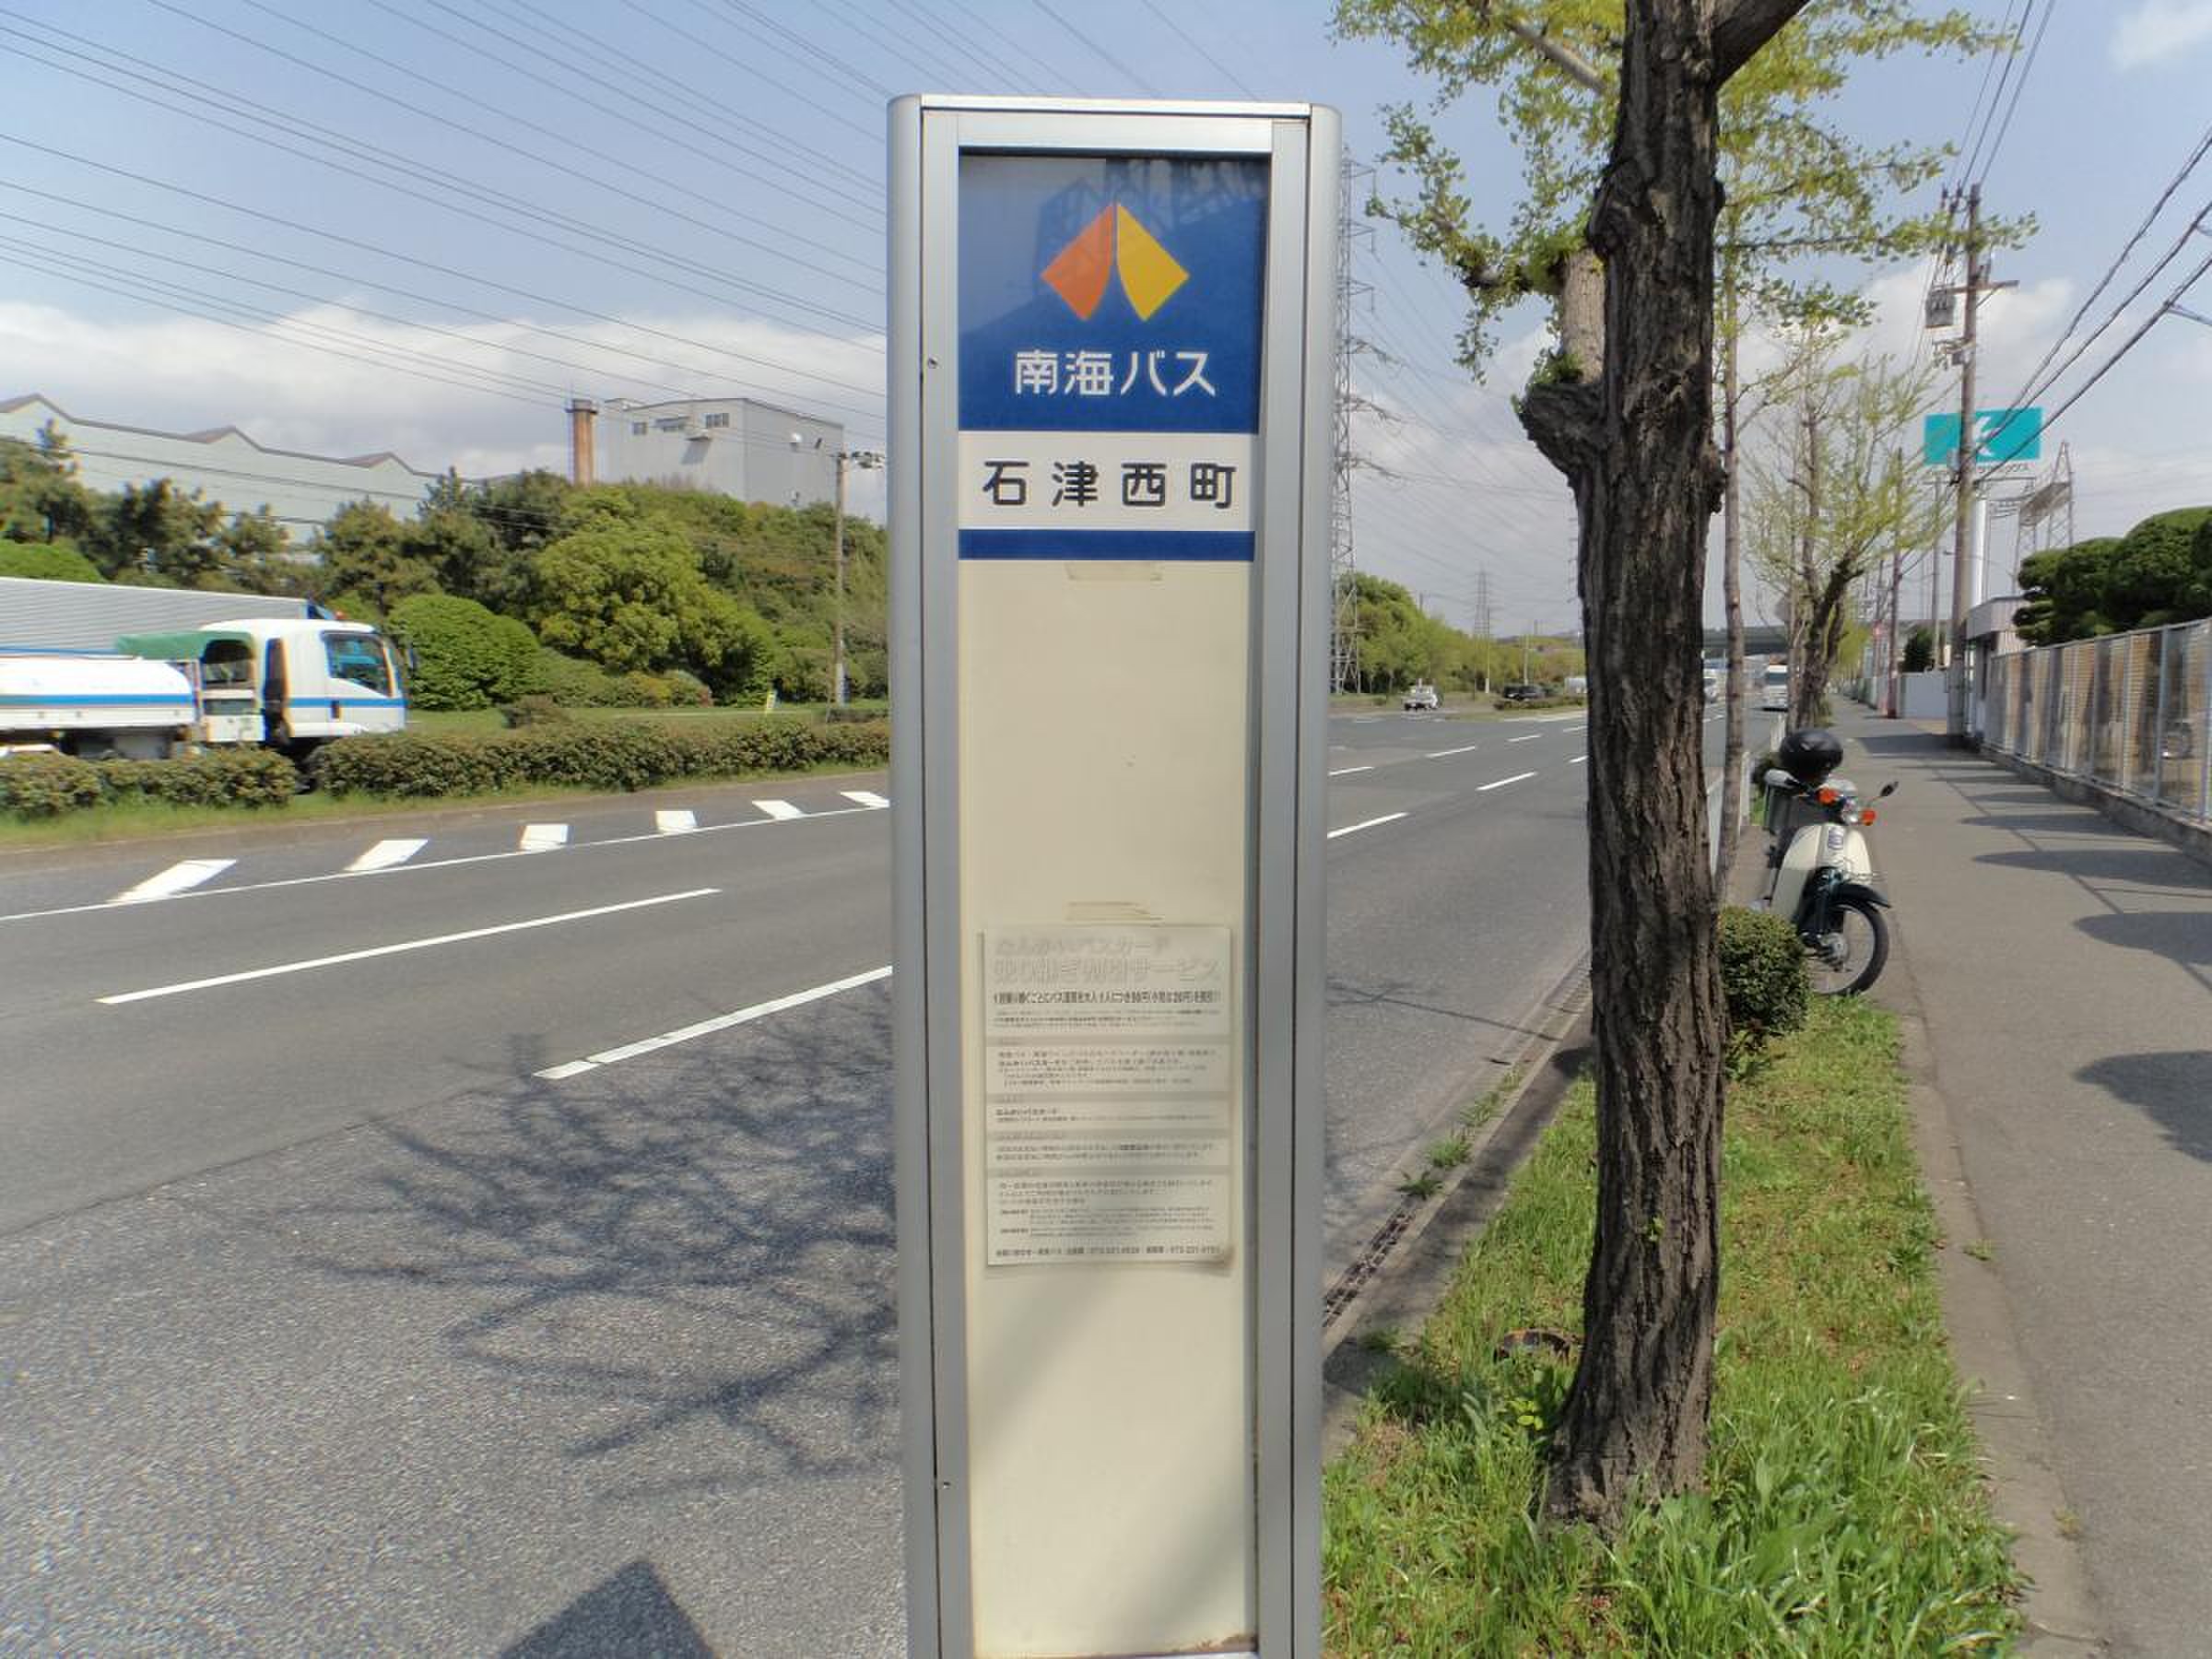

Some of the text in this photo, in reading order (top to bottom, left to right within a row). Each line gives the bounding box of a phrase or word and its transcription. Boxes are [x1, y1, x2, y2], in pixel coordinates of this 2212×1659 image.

[1016, 349, 1216, 396] 南海バス
[982, 461, 1236, 508] 石津西町
